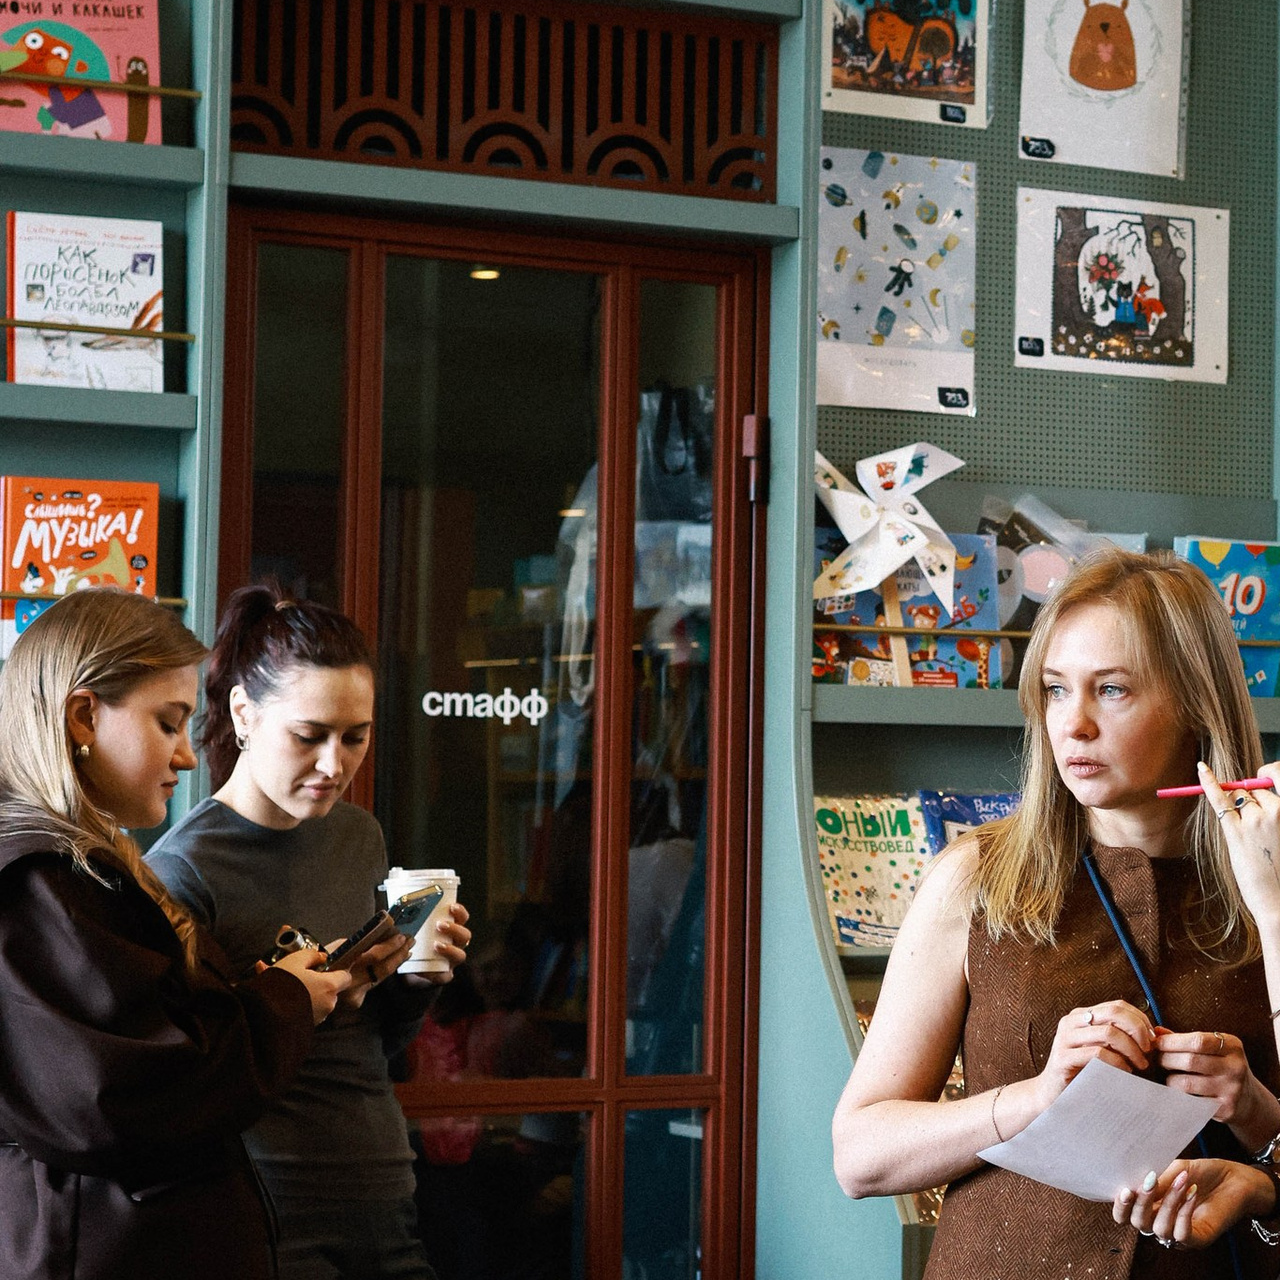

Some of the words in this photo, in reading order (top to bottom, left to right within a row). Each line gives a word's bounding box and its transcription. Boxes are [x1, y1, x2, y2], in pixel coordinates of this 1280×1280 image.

[72, 4, 145, 19] КАКАШЕК
[58, 245, 97, 264] КАК
[12, 509, 144, 569] МУЗЫКА!
[1219, 572, 1266, 616] 10
[422, 687, 549, 726] стафф
